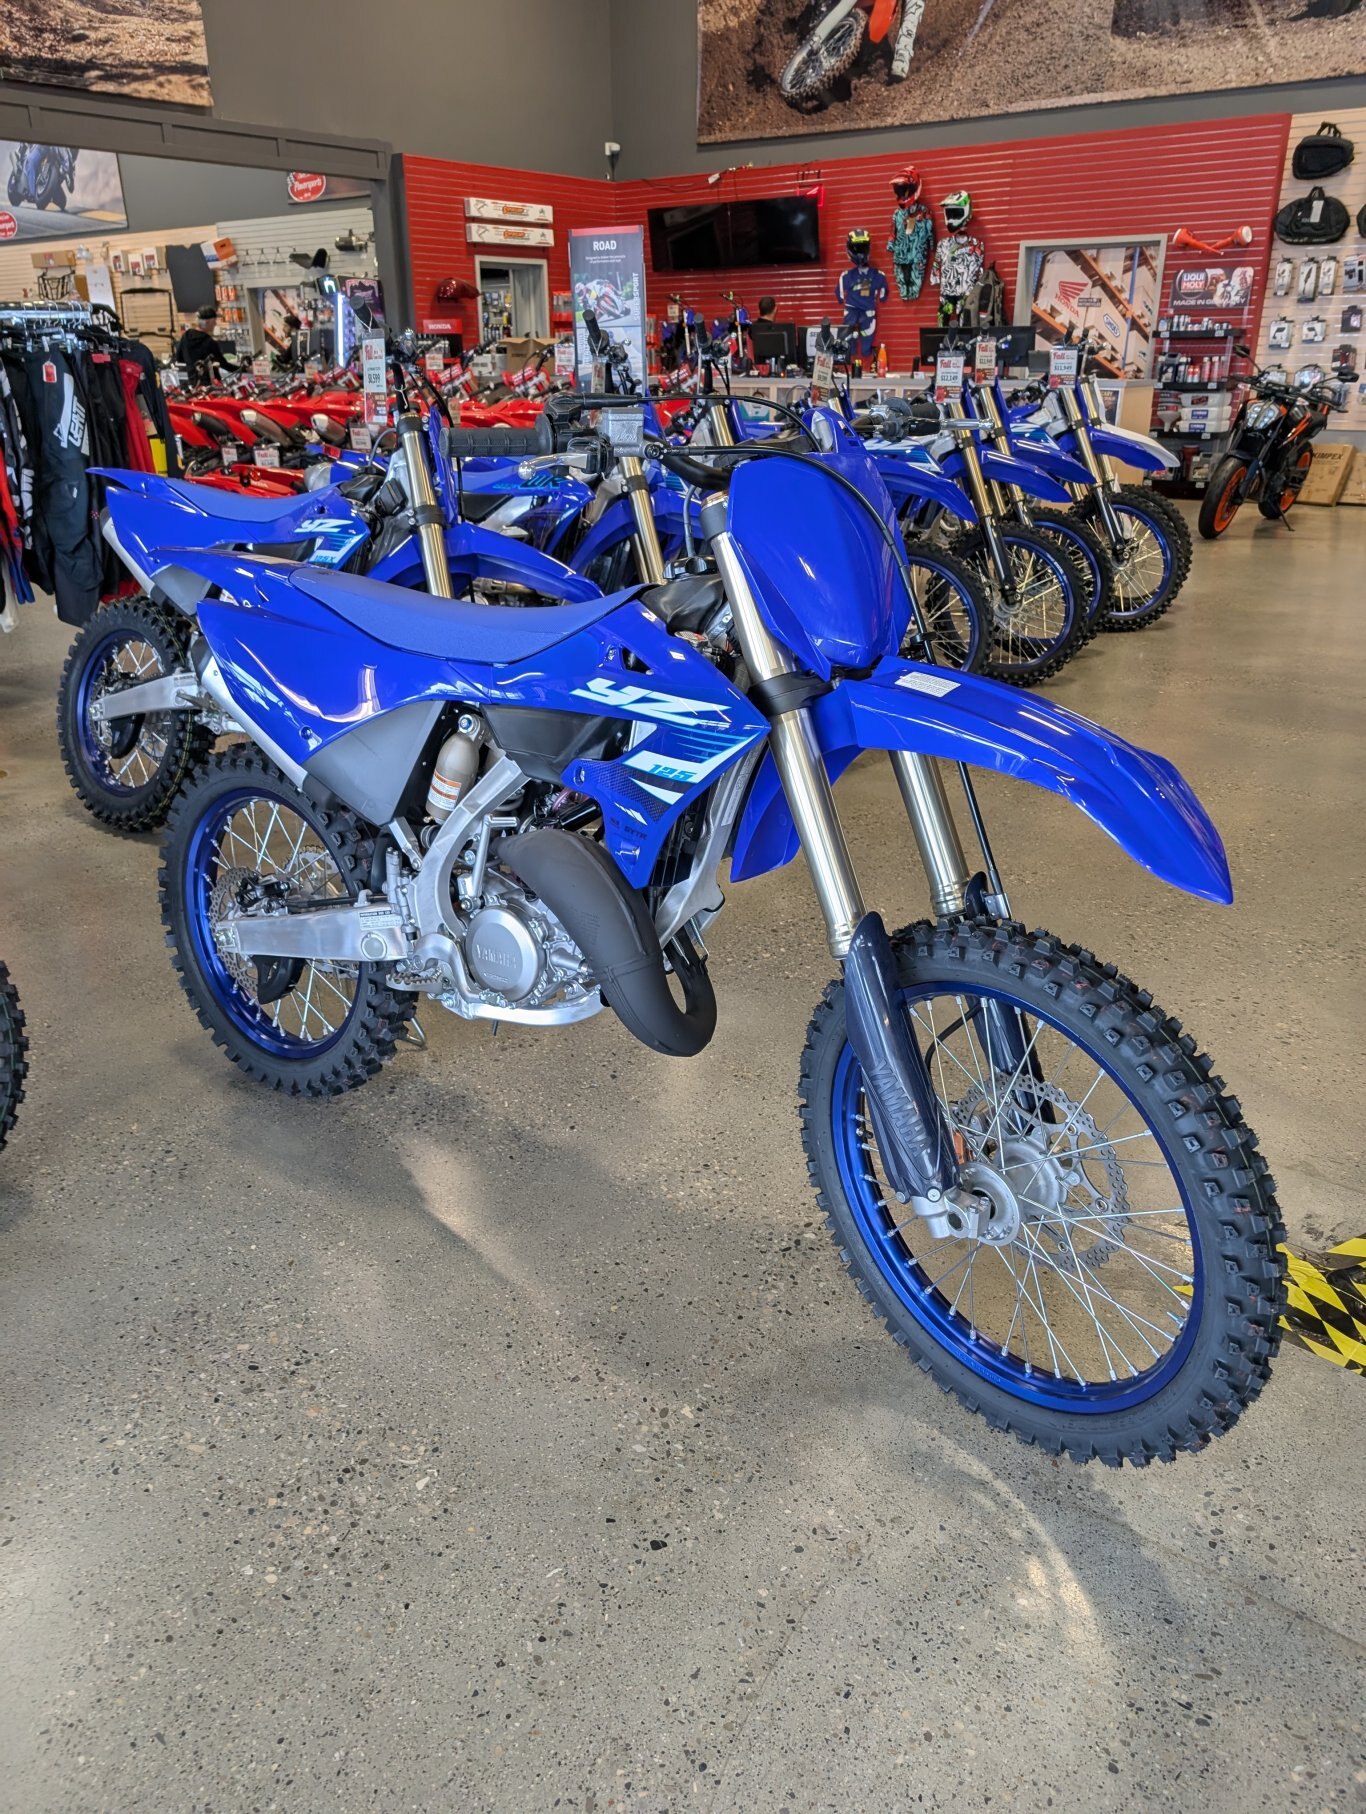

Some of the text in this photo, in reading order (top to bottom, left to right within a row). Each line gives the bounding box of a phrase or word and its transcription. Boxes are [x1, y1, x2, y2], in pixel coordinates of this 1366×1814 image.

[593, 240, 617, 251] ROAD
[1183, 272, 1206, 281] LIQUI
[1182, 280, 1204, 289] MOLY
[632, 272, 640, 321] SUPERSPORT
[1055, 293, 1080, 318] HONDA
[1053, 352, 1065, 360] Fall
[940, 360, 951, 368] Fall
[294, 519, 354, 532] YZ
[569, 677, 732, 726] YZ
[649, 764, 697, 781] 125
[476, 944, 517, 969] YAMAHA
[870, 1059, 931, 1158] YAMAHA
